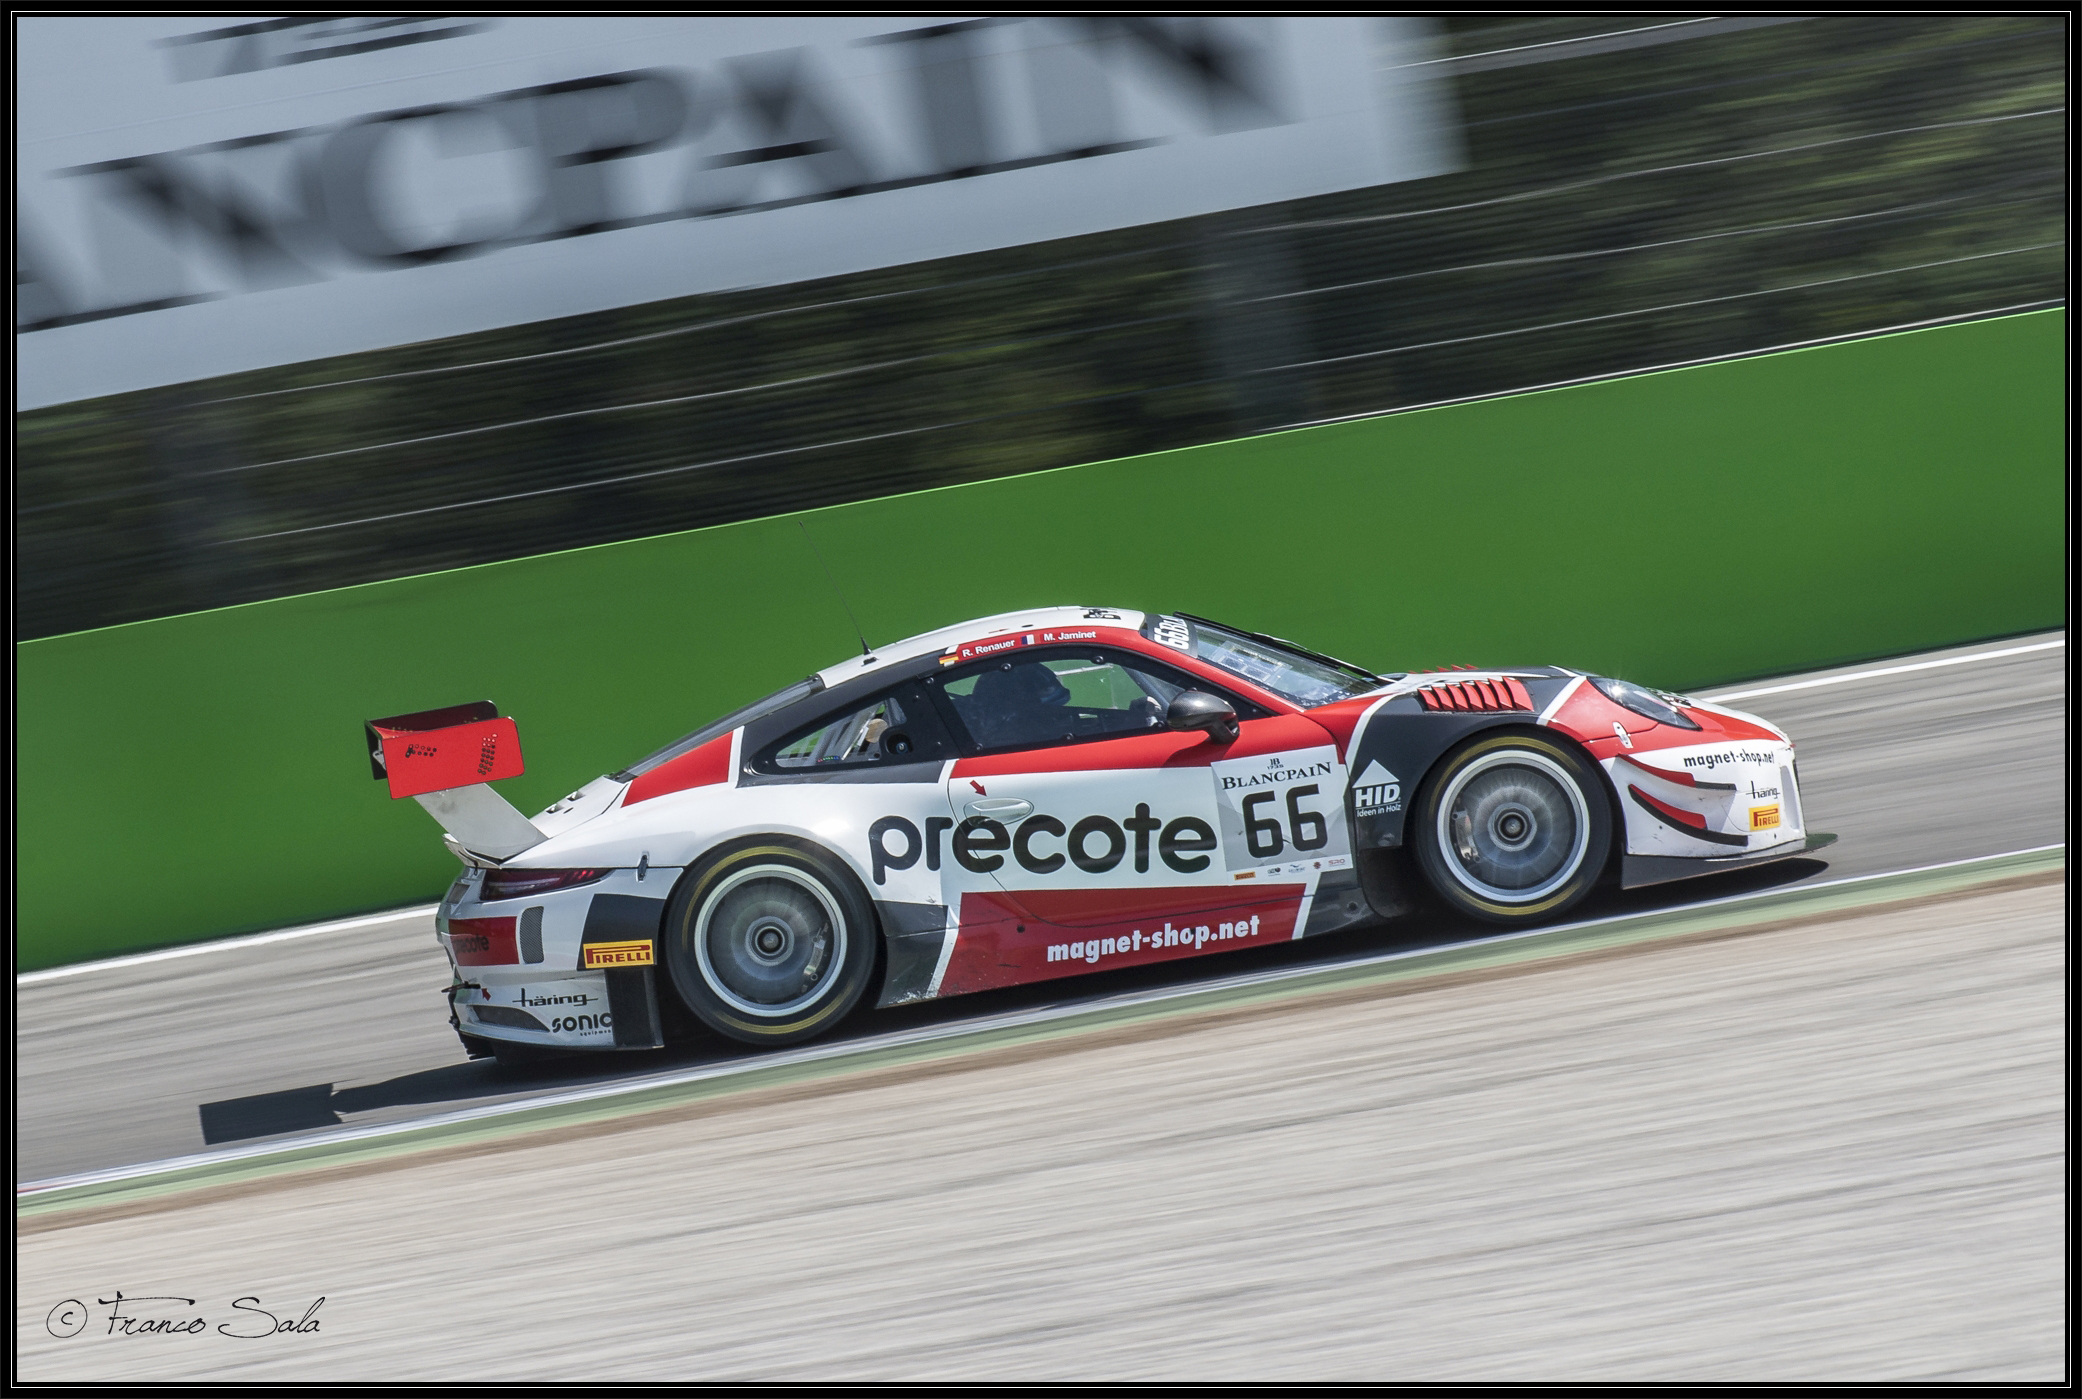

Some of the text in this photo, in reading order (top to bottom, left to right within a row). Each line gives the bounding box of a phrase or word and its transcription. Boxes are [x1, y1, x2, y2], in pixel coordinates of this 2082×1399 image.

[962, 630, 1097, 658] R. Renauer M. Jaminet
[1684, 749, 1775, 769] magnet-shop.net
[1221, 762, 1331, 789] BLANCPAIN
[1355, 784, 1400, 807] HID
[1242, 784, 1328, 859] 66
[1356, 804, 1402, 818] Ideen in Holz
[1753, 808, 1779, 827] PIRELLI
[868, 802, 1218, 886] precote
[1047, 915, 1261, 964] magnet-shop.net
[586, 945, 651, 965] PIRELLI
[512, 988, 598, 1007] häring
